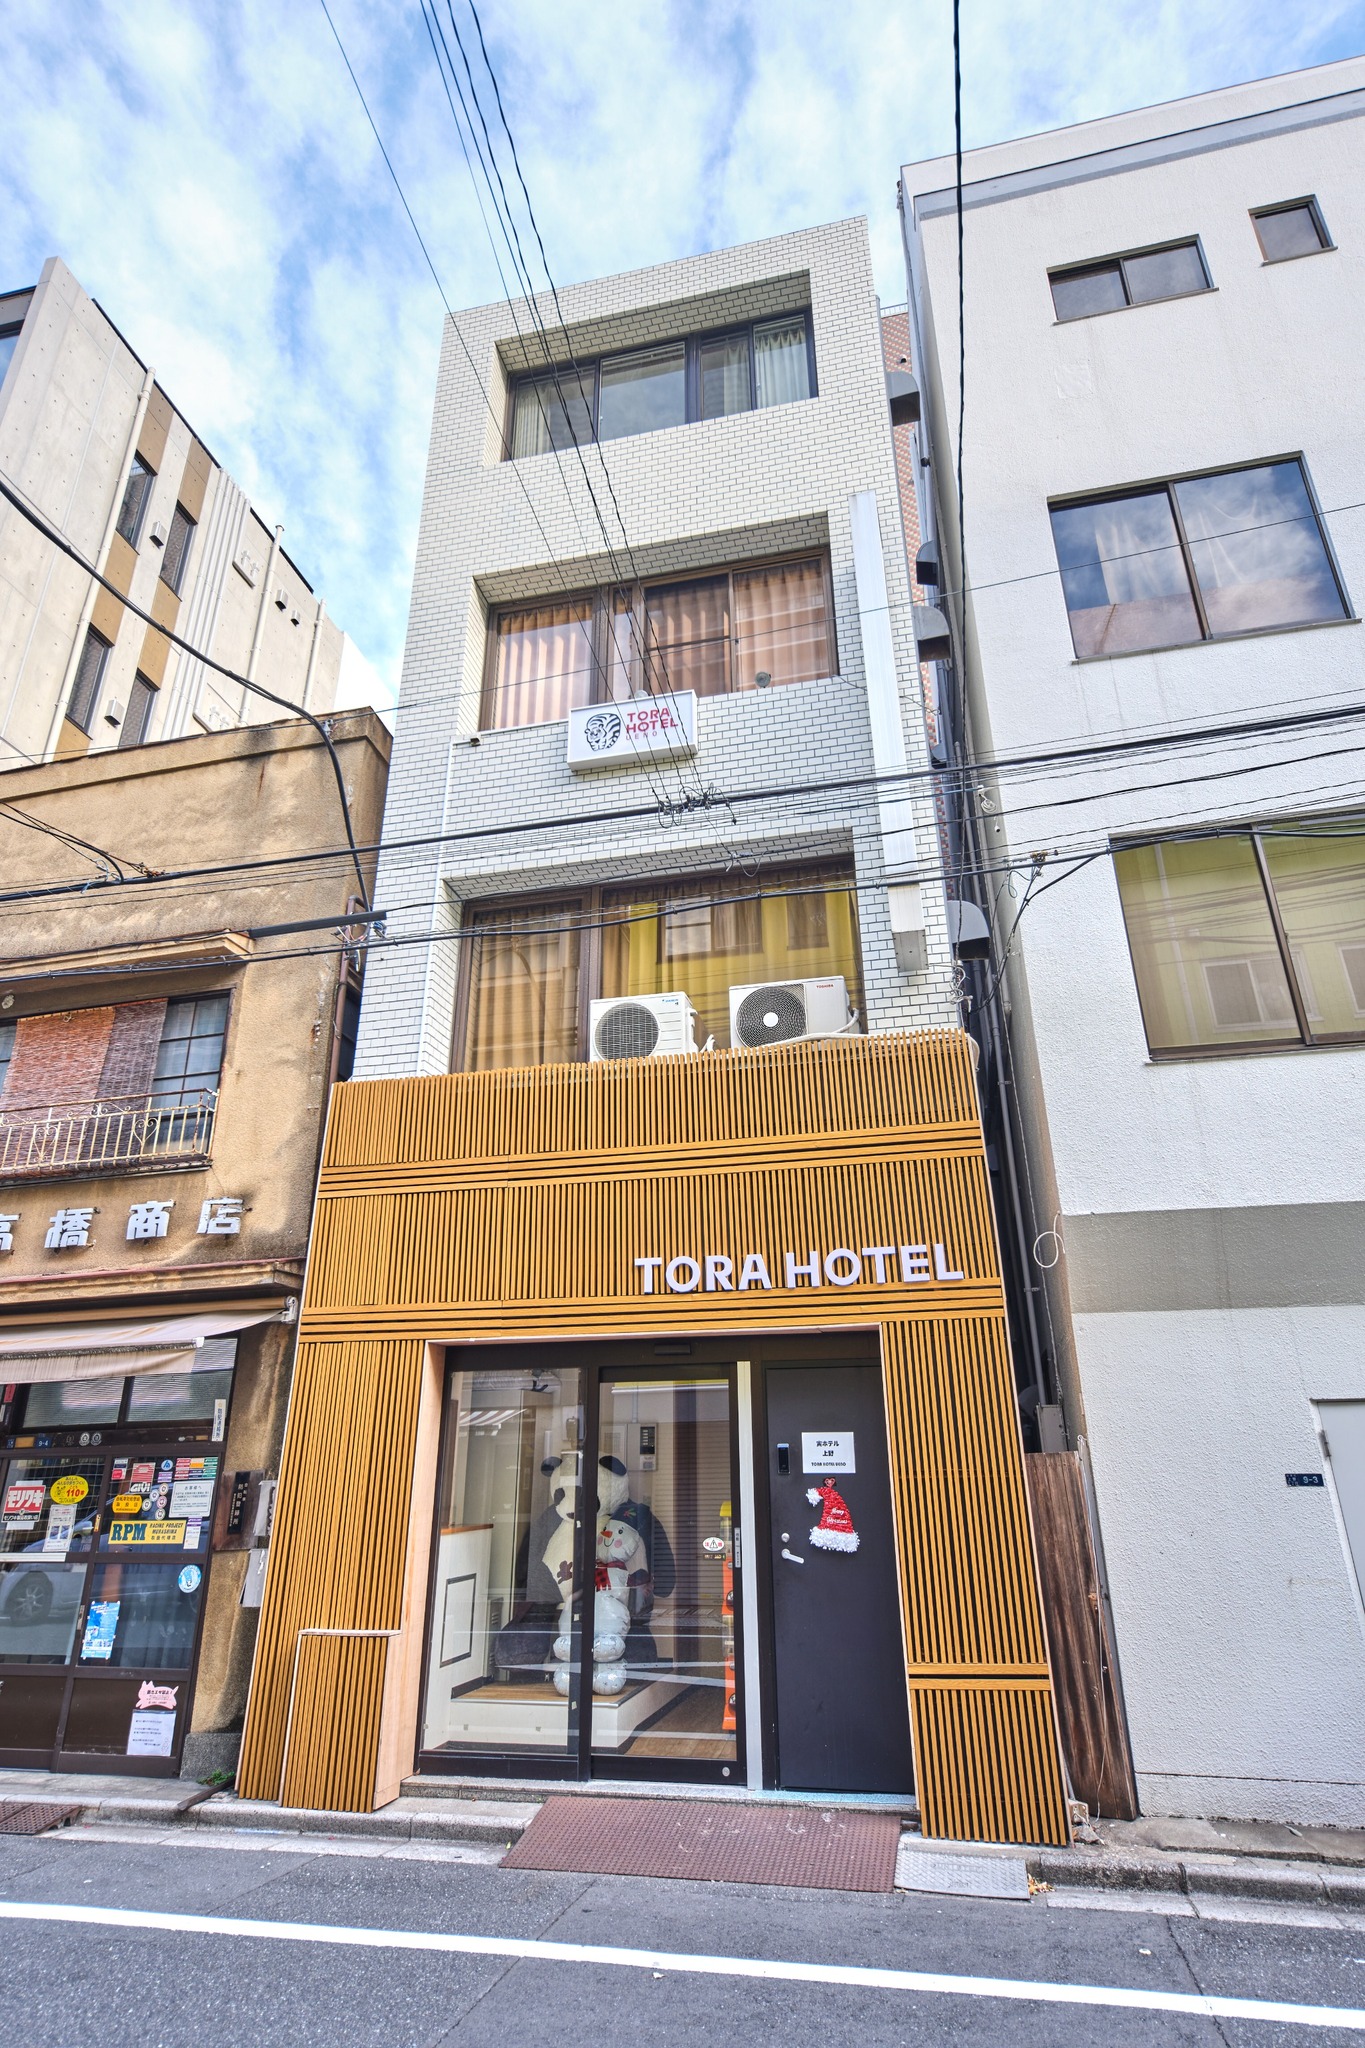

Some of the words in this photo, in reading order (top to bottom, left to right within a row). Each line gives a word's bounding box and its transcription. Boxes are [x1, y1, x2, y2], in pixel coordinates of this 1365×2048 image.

[627, 708, 670, 722] TORA
[626, 718, 678, 733] HOTEL
[626, 731, 657, 740] UENO
[634, 1253, 772, 1294] TORA
[785, 1243, 964, 1290] HOTEL
[1302, 1475, 1319, 1484] 9-3
[8, 1489, 44, 1508] モリワキ
[111, 1523, 148, 1541] RPM
